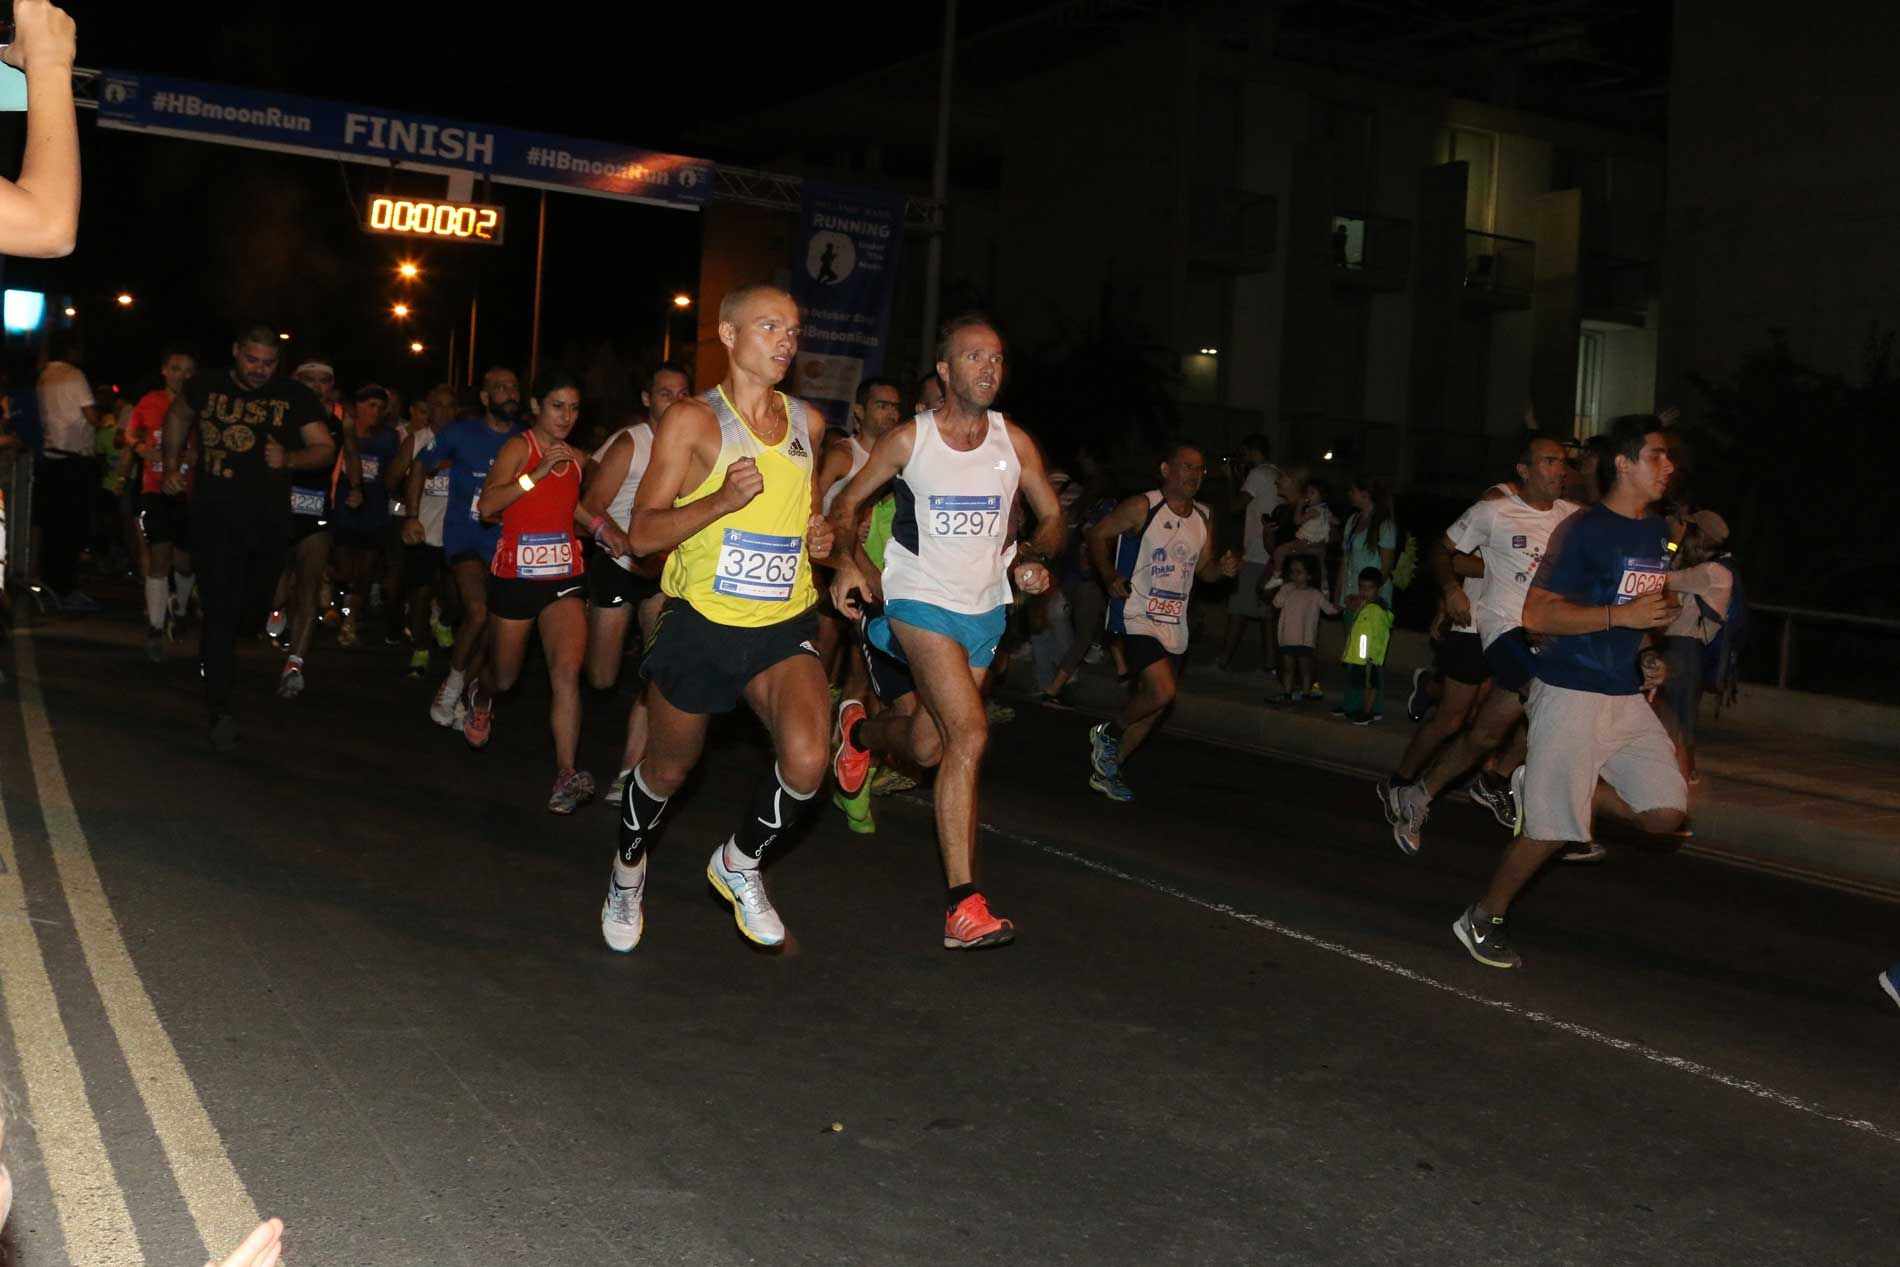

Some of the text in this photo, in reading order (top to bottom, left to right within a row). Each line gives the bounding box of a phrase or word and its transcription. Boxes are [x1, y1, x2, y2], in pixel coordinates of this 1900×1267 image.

[152, 91, 312, 133] #HBmoonRun
[343, 111, 496, 166] FINISH
[527, 146, 671, 186] #HBmoonRun
[813, 213, 892, 238] RUNNING
[200, 391, 290, 427] JUST
[935, 511, 1000, 537] 3297
[522, 544, 571, 565] 0219
[724, 549, 798, 582] 3263
